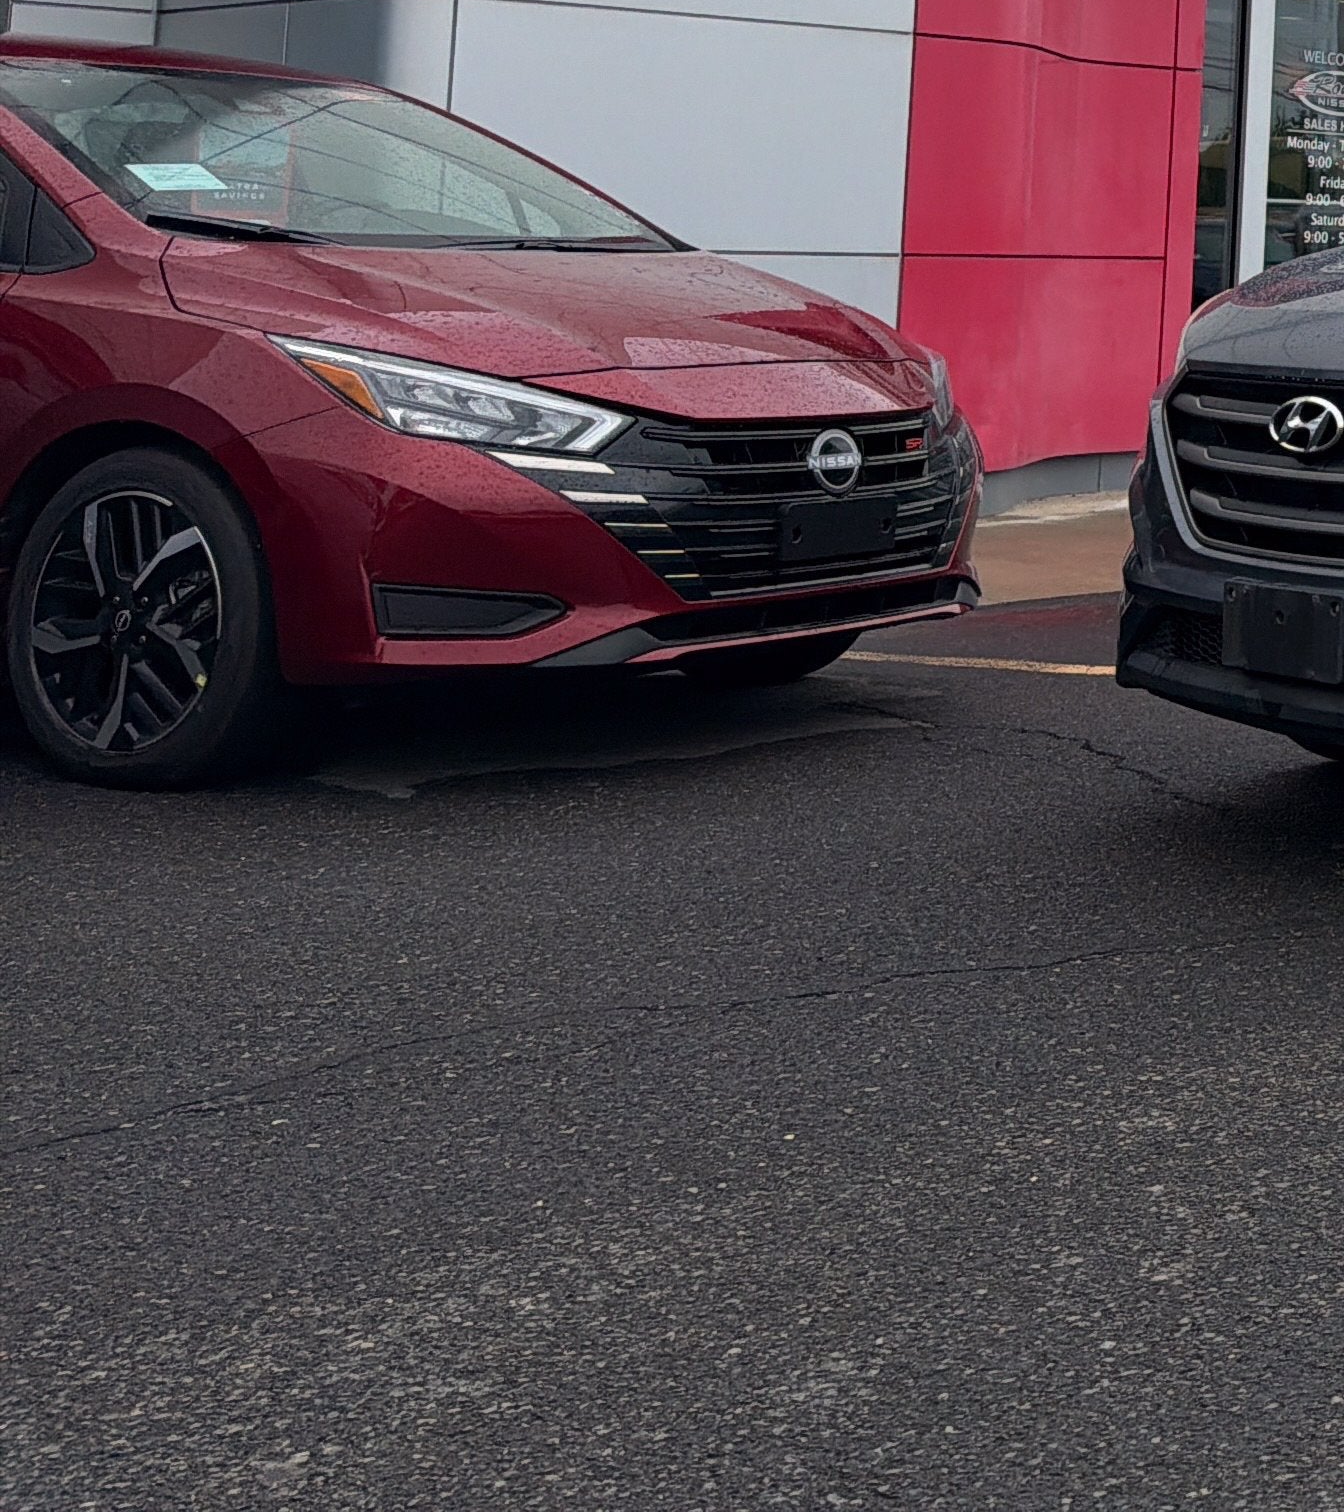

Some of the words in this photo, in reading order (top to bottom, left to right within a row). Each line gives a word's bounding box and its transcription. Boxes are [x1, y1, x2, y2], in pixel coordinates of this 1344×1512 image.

[1303, 118, 1338, 132] SALES
[1287, 136, 1331, 153] Monday
[1307, 155, 1333, 169] 9:00
[1305, 193, 1331, 207] 9:00
[1303, 231, 1329, 244] 9:00
[905, 437, 924, 451] SR
[808, 454, 862, 469] NISSAN
